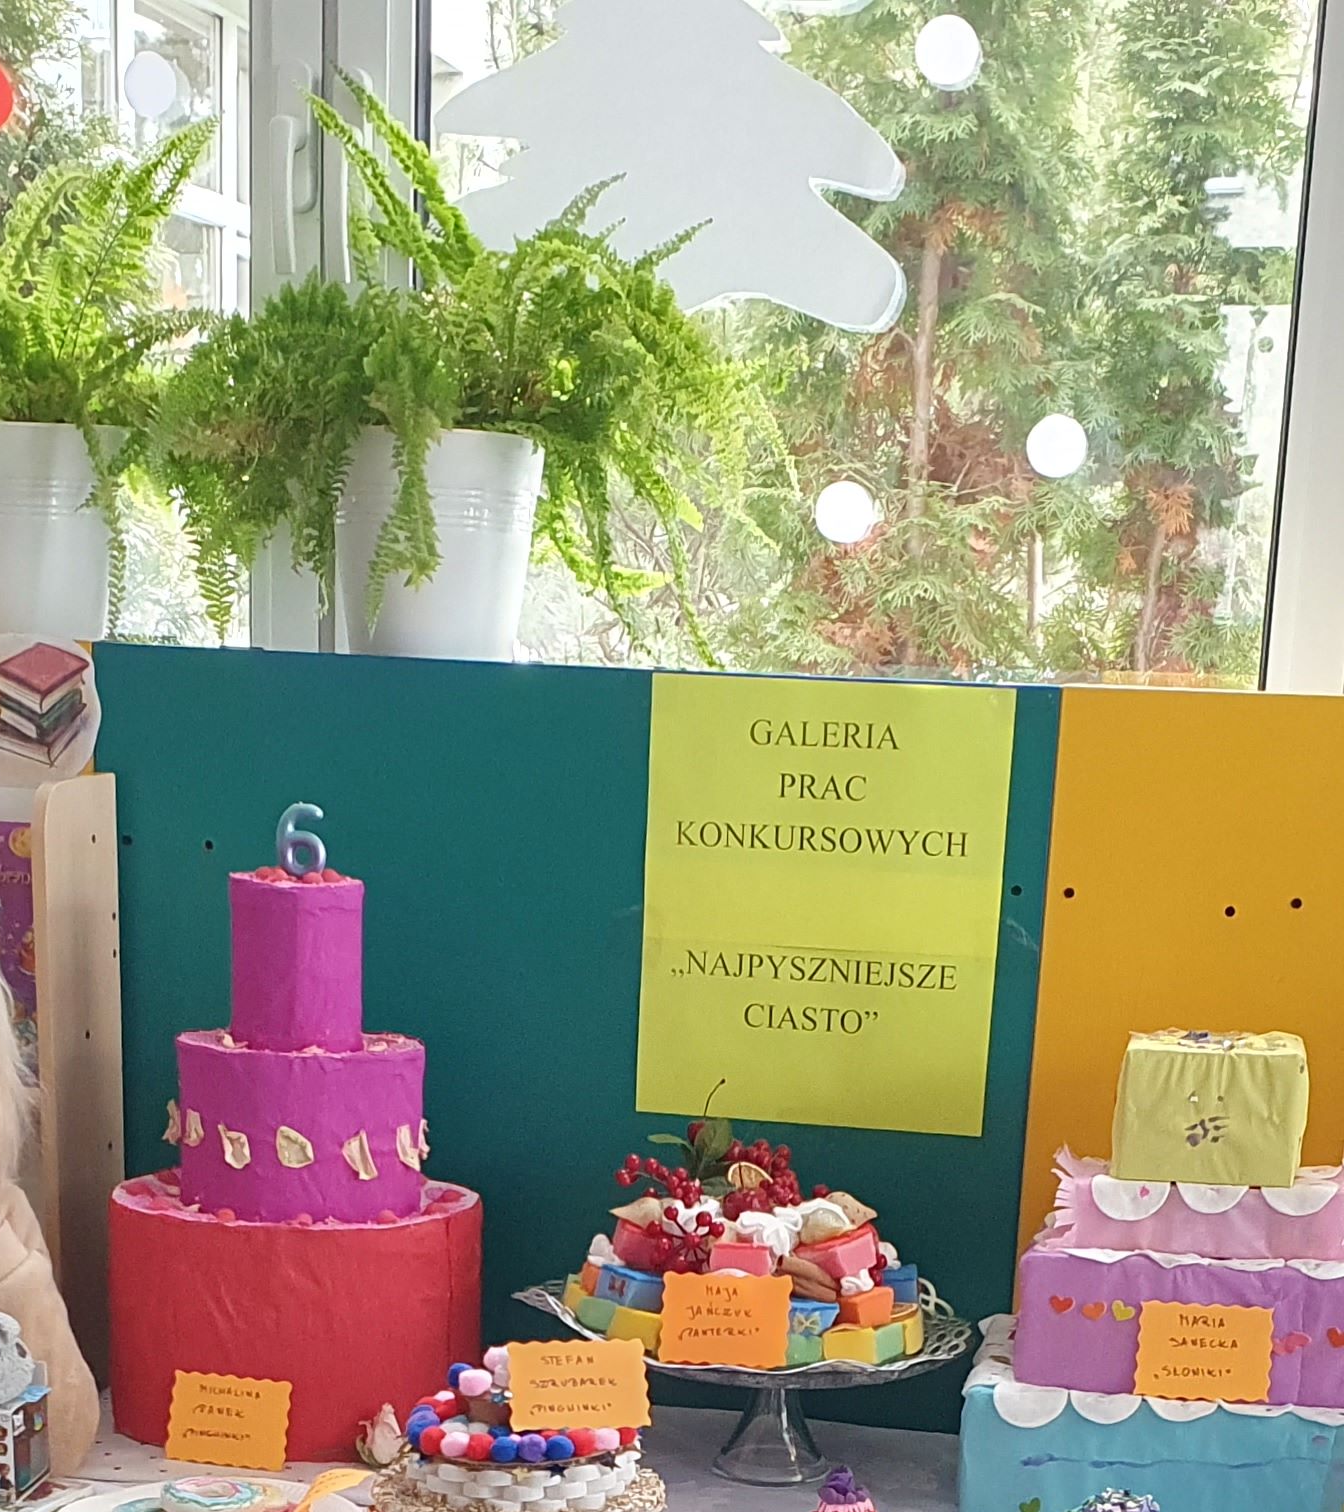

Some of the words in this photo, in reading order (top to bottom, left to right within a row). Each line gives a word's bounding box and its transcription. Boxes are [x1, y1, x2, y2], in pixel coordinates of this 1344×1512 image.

[749, 718, 900, 750] GALERIA
[779, 772, 868, 802] PRAC
[675, 819, 969, 859] KONKURSOWYCH
[670, 948, 958, 992] „NAJPYSZNIEJSZE
[743, 1001, 879, 1035] CIASTO”
[706, 1285, 739, 1302] MAJA
[1179, 1313, 1226, 1328] MARIA
[540, 1355, 595, 1366] STEFAN
[199, 1383, 261, 1400] MICHALINA
